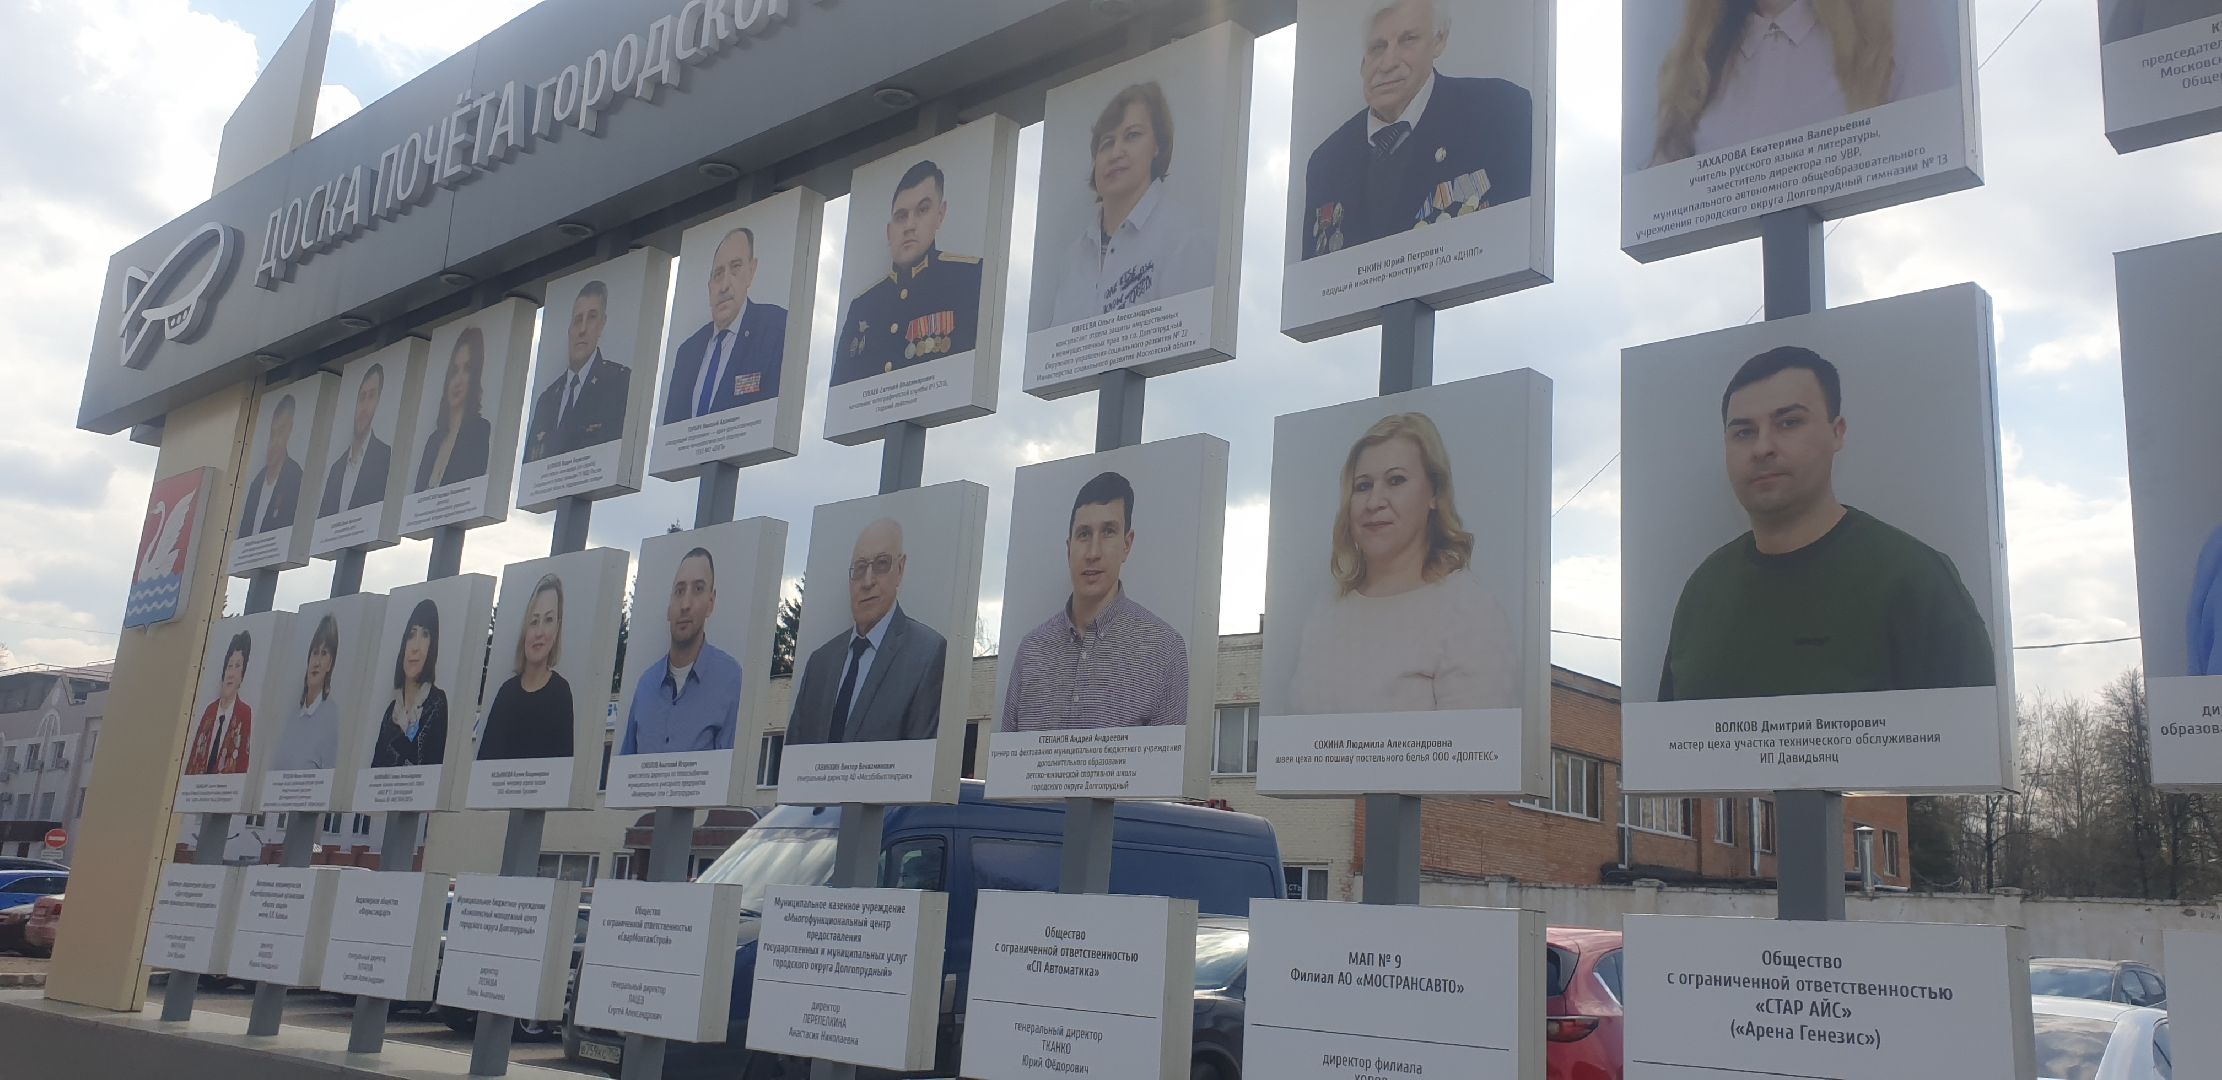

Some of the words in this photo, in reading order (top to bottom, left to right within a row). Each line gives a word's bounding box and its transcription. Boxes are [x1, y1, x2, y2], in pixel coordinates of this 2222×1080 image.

[1697, 150, 1747, 170] ЗАХАРОВА
[1751, 135, 1804, 156] Екатерина
[1807, 117, 1871, 141] Валерьевна
[1689, 168, 1727, 186] учитель
[1729, 158, 1771, 177] русского
[1774, 152, 1804, 165] языка
[1816, 129, 1881, 152] литературы,
[254, 166, 369, 289] ДОСКА
[372, 81, 528, 218] ПОЧЁТА
[1653, 195, 1732, 221] муниципального
[1734, 177, 1799, 199] автономного
[1802, 146, 1926, 184] общеобразовательного
[1706, 172, 1766, 194] заместитель
[1768, 159, 1822, 179] директора
[1824, 157, 1837, 165] по
[1636, 218, 1692, 239] учреждения
[1695, 204, 1747, 224] городского
[1751, 196, 1784, 212] округа
[1787, 175, 1862, 206] Долгопрудный
[1866, 165, 1918, 184] гимназии
[1922, 158, 1935, 171] №
[1938, 154, 1948, 165] 13
[1357, 264, 1382, 275] ЕЧКИН
[1384, 257, 1405, 269] Юрий
[1407, 246, 1444, 263] Петрович
[1435, 256, 1451, 266] ПАО
[1714, 720, 1758, 733] ВОЛКОВ
[1761, 719, 1812, 734] Дмитрий
[1816, 718, 1886, 732] Викторович
[1039, 735, 1069, 744] СТЕПАНОВ
[1070, 734, 1093, 744] Андрей
[1314, 740, 1344, 750] СОХИНА
[1346, 740, 1385, 750] Людмила
[1387, 739, 1452, 749] Александровна
[1669, 739, 1704, 751] мастер
[1708, 739, 1731, 750] цеха
[1734, 737, 1775, 751] участка
[1779, 735, 1851, 748] технического
[1855, 732, 1941, 746] обслуживания
[1295, 754, 1312, 764] цеха
[1314, 754, 1323, 762] по
[1355, 754, 1404, 763] постельного
[1406, 752, 1430, 762] белья
[1432, 751, 1449, 762] ООО
[1452, 751, 1498, 762] «ДОЛТЕКС»
[1759, 752, 1774, 764] ИП
[1778, 751, 1839, 766] Давидьянц
[774, 897, 827, 909] Муниципальное
[862, 903, 905, 914] учреждение
[869, 918, 891, 930] центр
[1045, 926, 1086, 940] Общество
[807, 931, 862, 943] предоставления
[821, 947, 825, 955] и
[827, 948, 885, 961] муниципальных
[886, 952, 908, 964] услуг
[995, 943, 999, 952] с
[1001, 944, 1058, 957] ограниченной
[1060, 948, 1138, 962] ответственностью
[1348, 952, 1374, 966] МАП
[1378, 953, 1391, 968] №
[1394, 954, 1402, 968] 9
[1762, 951, 1842, 970] Общество
[772, 959, 809, 970] городского
[810, 961, 833, 973] округа
[834, 962, 892, 978] Долгопрудный»
[1027, 960, 1042, 973] «СП
[1044, 962, 1100, 977] Автоматика»
[1290, 967, 1334, 984] Филиал
[1338, 972, 1352, 986] АО
[1356, 974, 1464, 994] «МОСТРАНСАВТО»
[1667, 971, 1675, 985] с
[1679, 972, 1791, 992] ограниченной
[1796, 978, 1954, 1001] ответственностью
[811, 1001, 840, 1013] директор
[1755, 998, 1804, 1015] «СТАР
[1809, 999, 1852, 1019] АЙС»
[1014, 1021, 1064, 1036] генеральный
[1066, 1028, 1103, 1041] директор
[1730, 1019, 1794, 1041] («Арена
[1799, 1026, 1881, 1049] Генезис»)
[1042, 1039, 1071, 1054] ТКАНКО
[1022, 1055, 1043, 1069] Юрий
[1045, 1059, 1089, 1074] Фёдорович
[1322, 1054, 1372, 1071] директор
[1374, 1057, 1422, 1075] филиала
